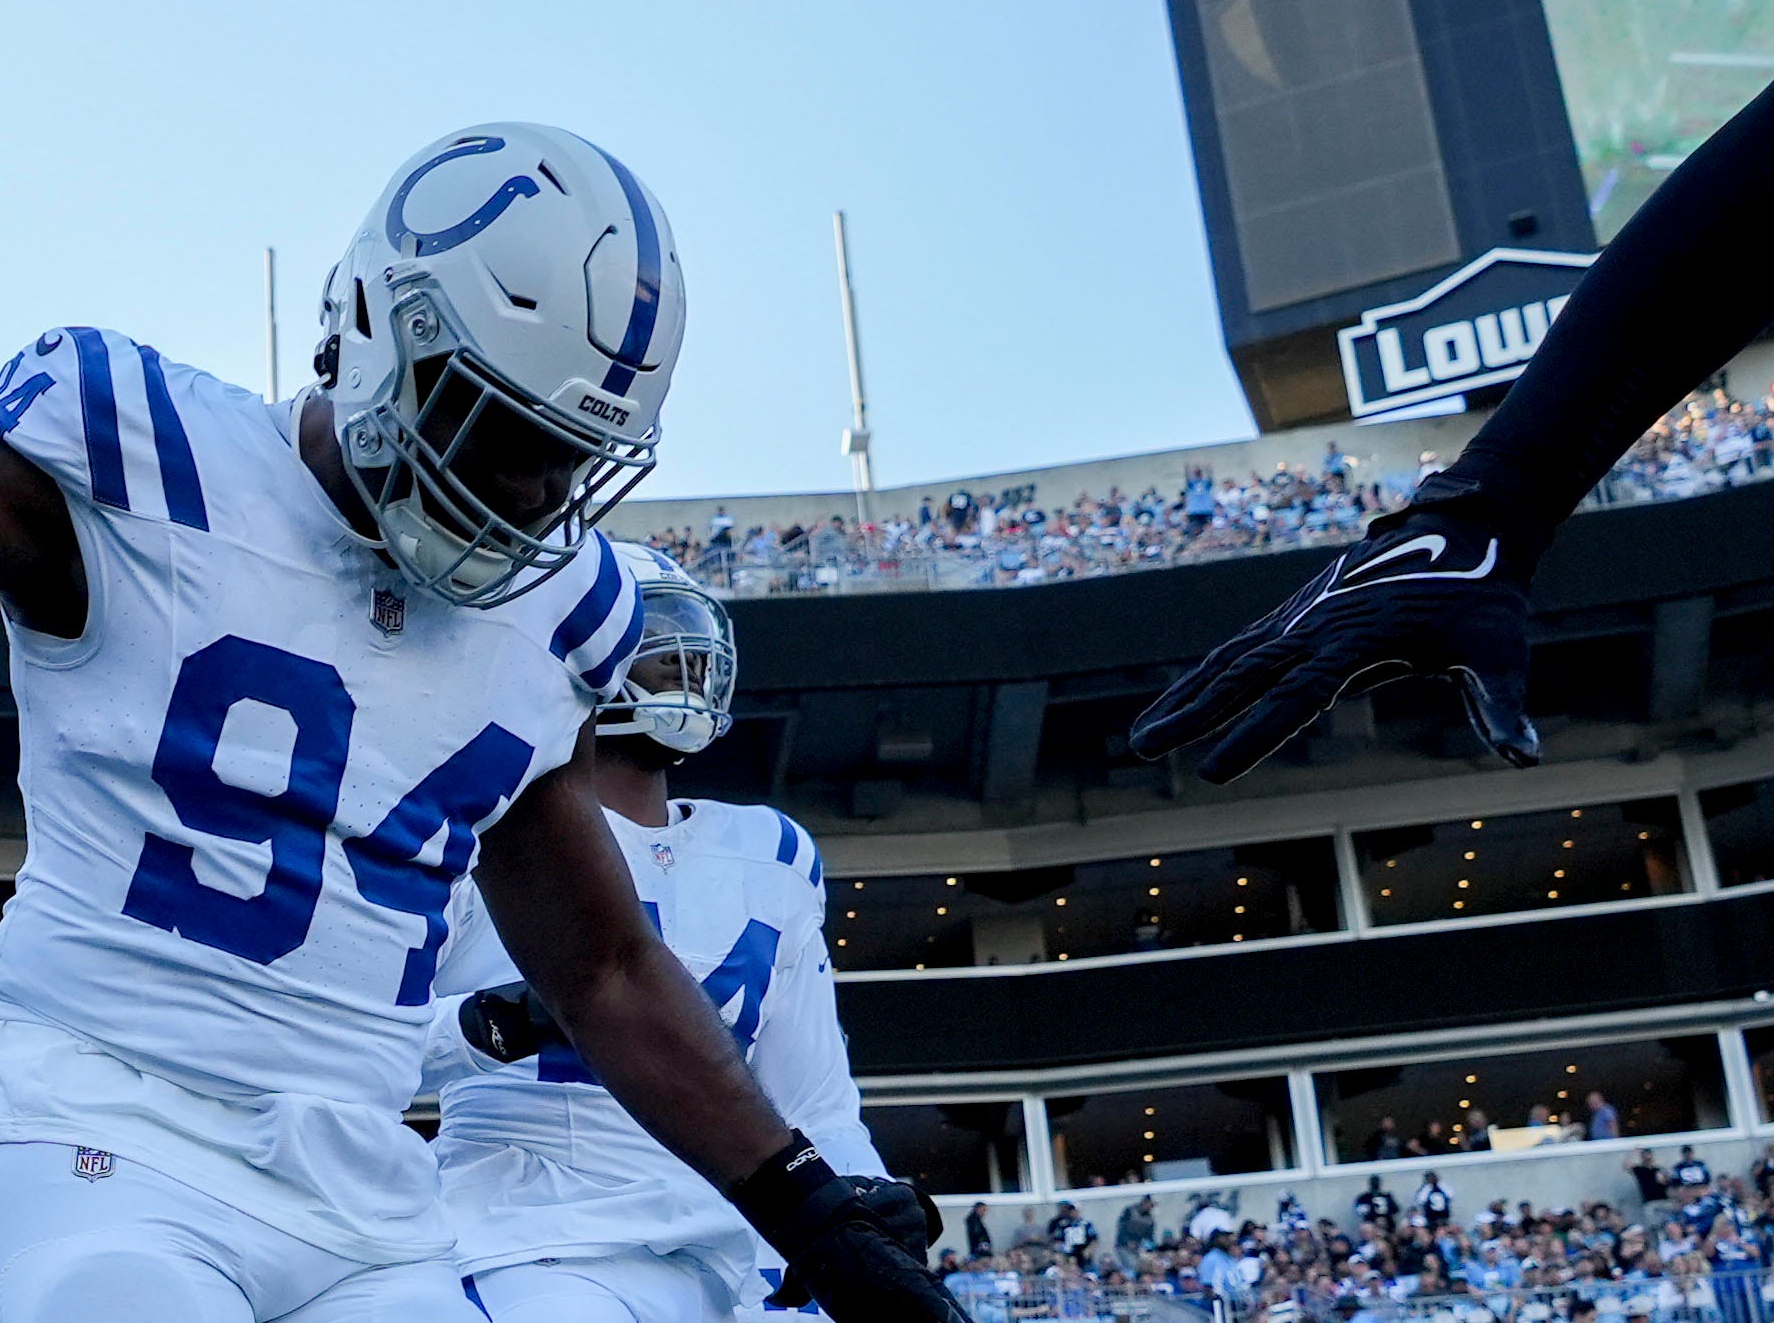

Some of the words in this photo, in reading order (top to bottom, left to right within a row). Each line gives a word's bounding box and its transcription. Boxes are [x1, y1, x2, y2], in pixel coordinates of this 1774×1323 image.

[578, 394, 630, 427] COLTS
[121, 633, 536, 1006] 94
[79, 1156, 108, 1173] NFL
